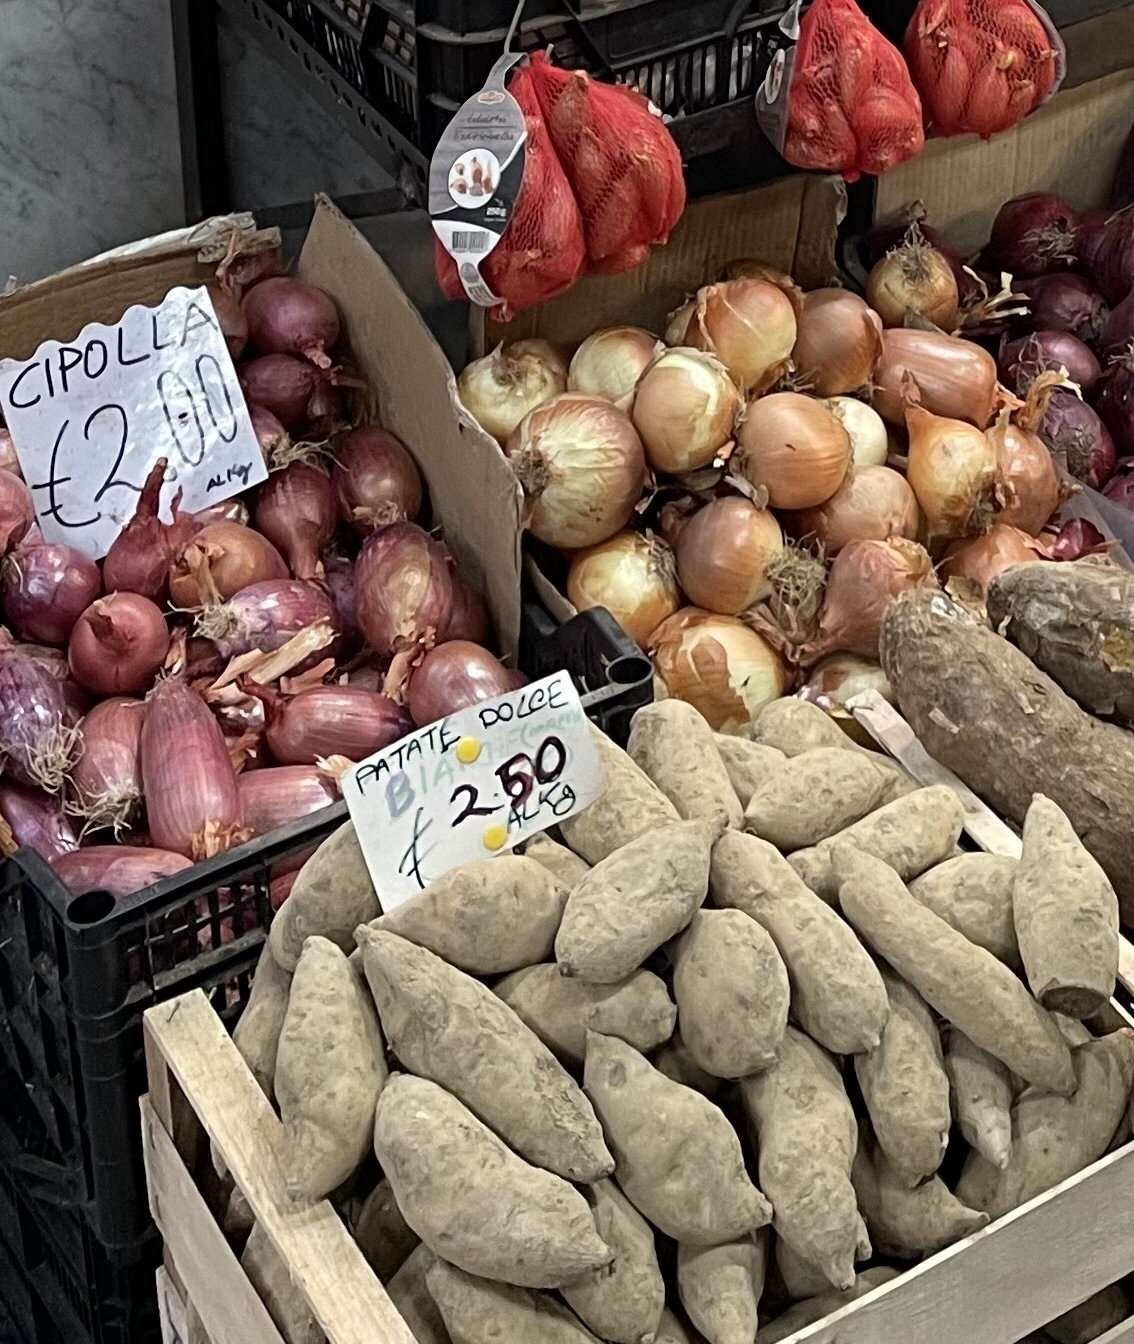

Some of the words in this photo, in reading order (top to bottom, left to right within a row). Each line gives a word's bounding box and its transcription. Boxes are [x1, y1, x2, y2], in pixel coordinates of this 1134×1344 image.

[9, 302, 219, 409] CIPOLLA
[355, 718, 461, 796] PATATE
[478, 679, 569, 729] DOLCE
